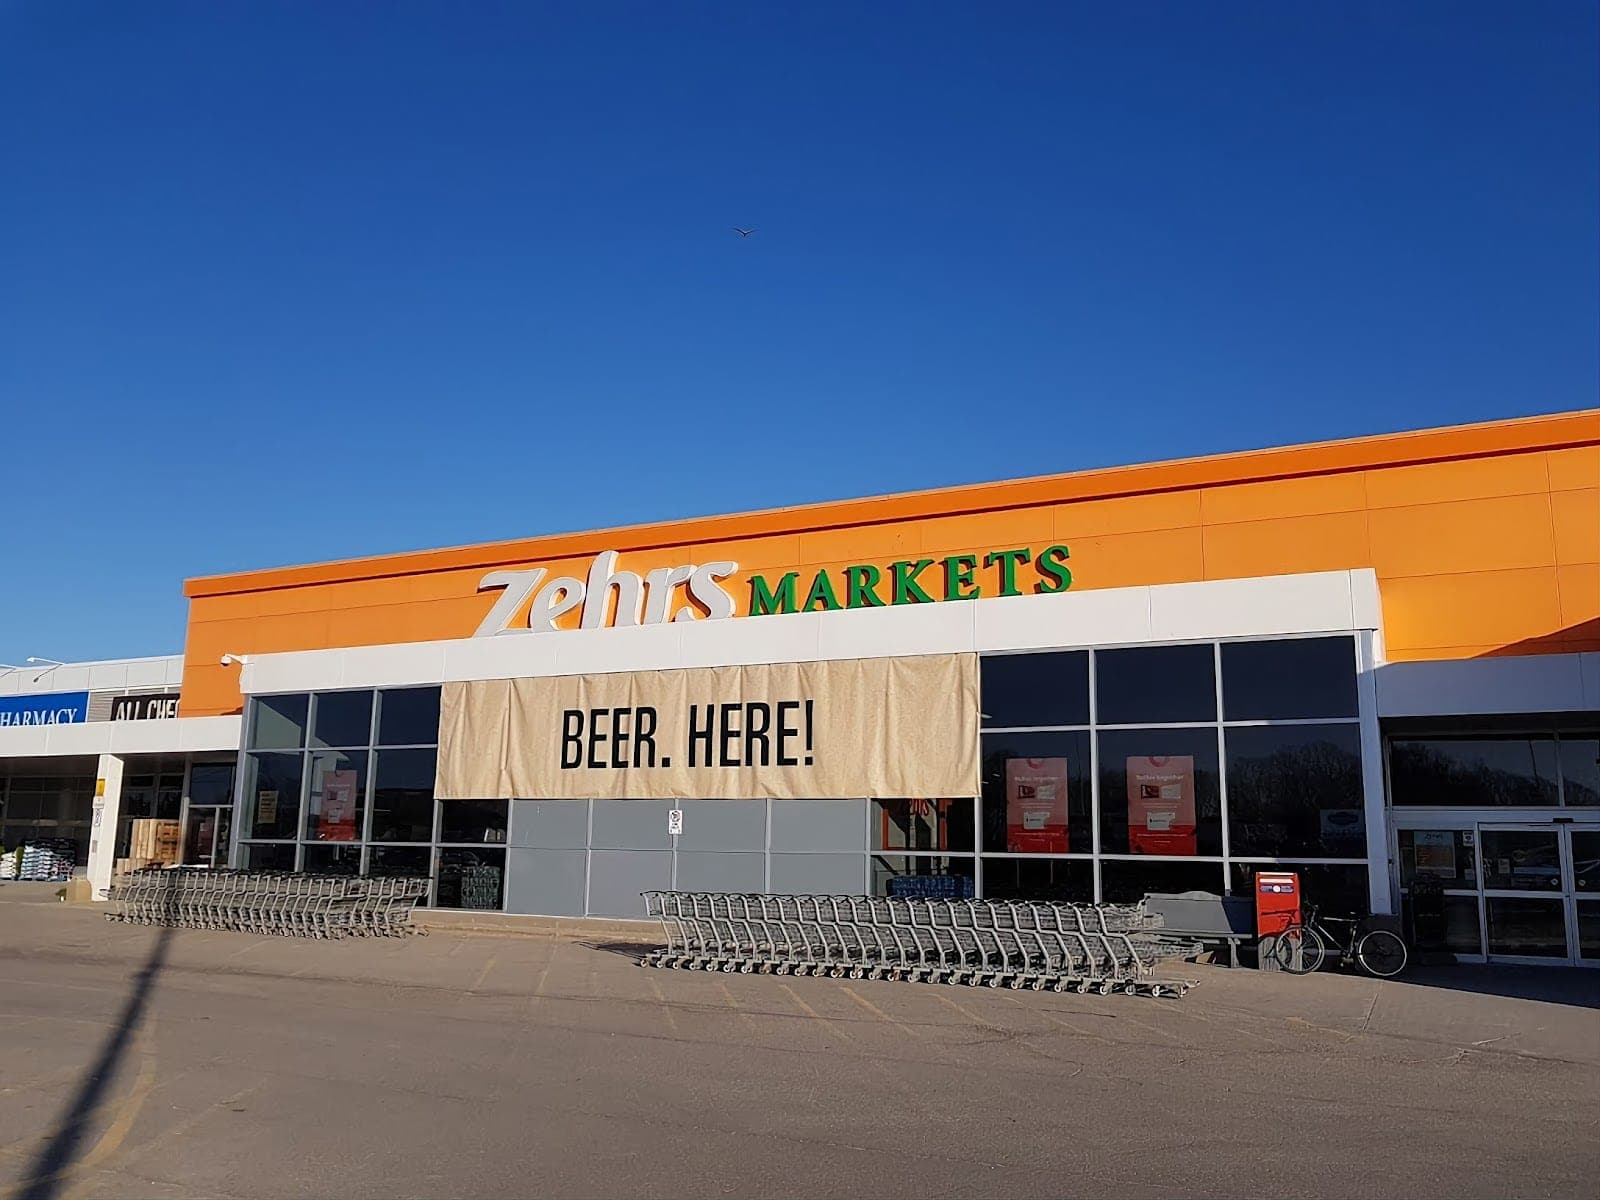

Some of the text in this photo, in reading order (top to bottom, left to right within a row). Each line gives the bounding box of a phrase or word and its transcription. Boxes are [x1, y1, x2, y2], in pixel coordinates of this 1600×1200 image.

[472, 545, 1073, 638] Zehrs MARKETS
[0, 708, 78, 726] HARMACY
[561, 699, 814, 769] BEER. HERE!
